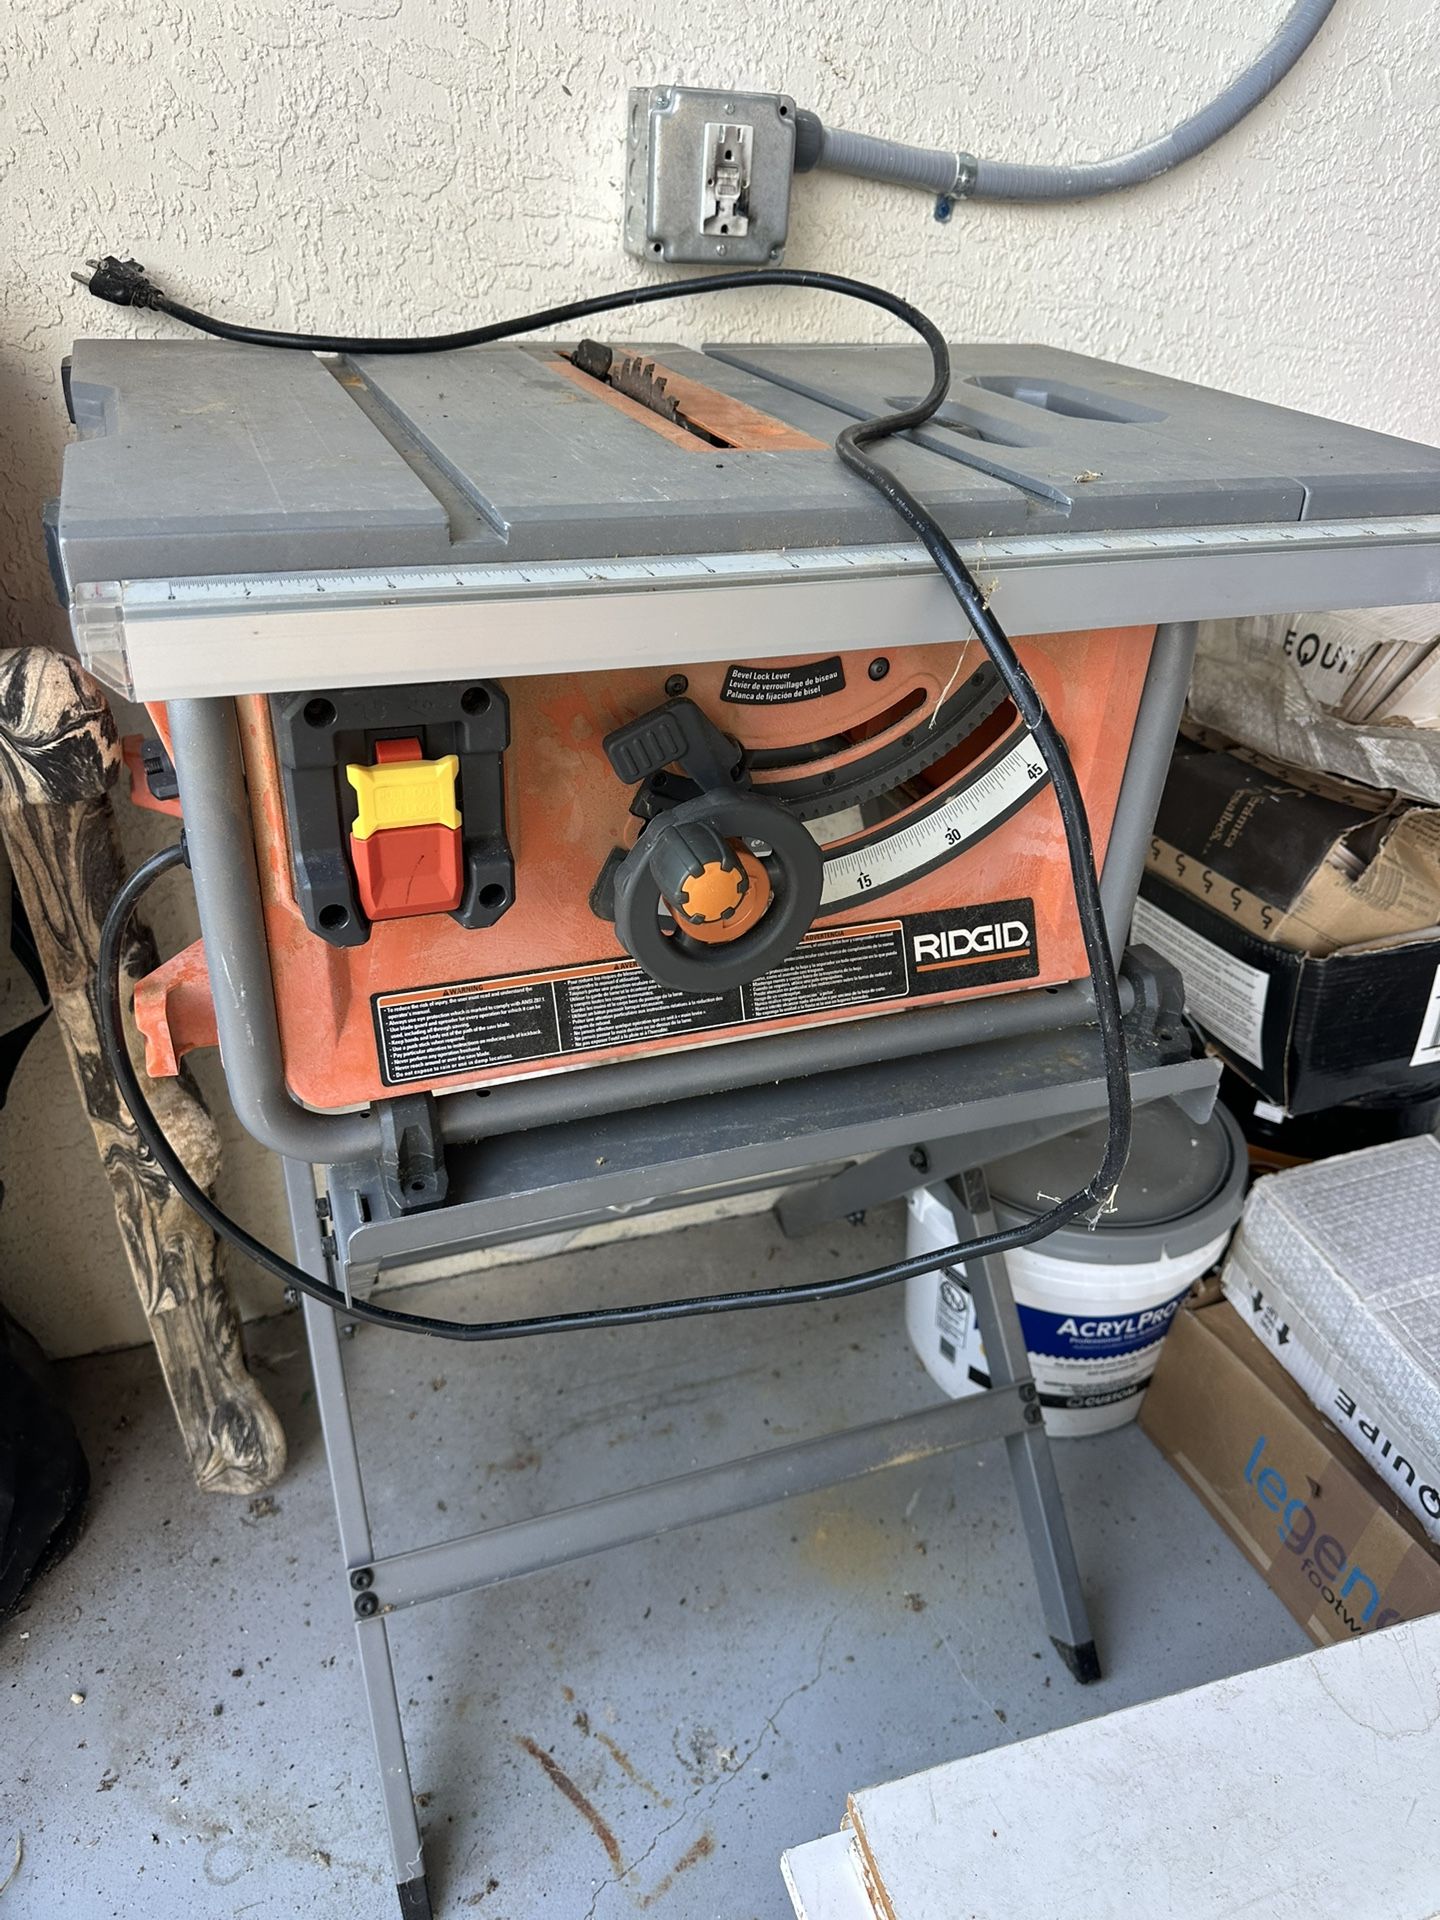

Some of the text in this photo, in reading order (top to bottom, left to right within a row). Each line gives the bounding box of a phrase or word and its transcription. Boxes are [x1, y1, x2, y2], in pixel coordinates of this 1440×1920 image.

[729, 680, 750, 689] Levier
[752, 682, 760, 690] de
[762, 680, 803, 690] verrouillage
[815, 672, 837, 683] biseau
[732, 670, 752, 679] Bevel
[726, 689, 754, 700] Palanca
[766, 691, 792, 701] fijación
[804, 686, 820, 696] bisel
[1027, 763, 1043, 781] 45
[945, 829, 961, 846] 30
[857, 873, 872, 890] 15
[914, 921, 1029, 962] RIDGID
[449, 984, 483, 994] WARNING
